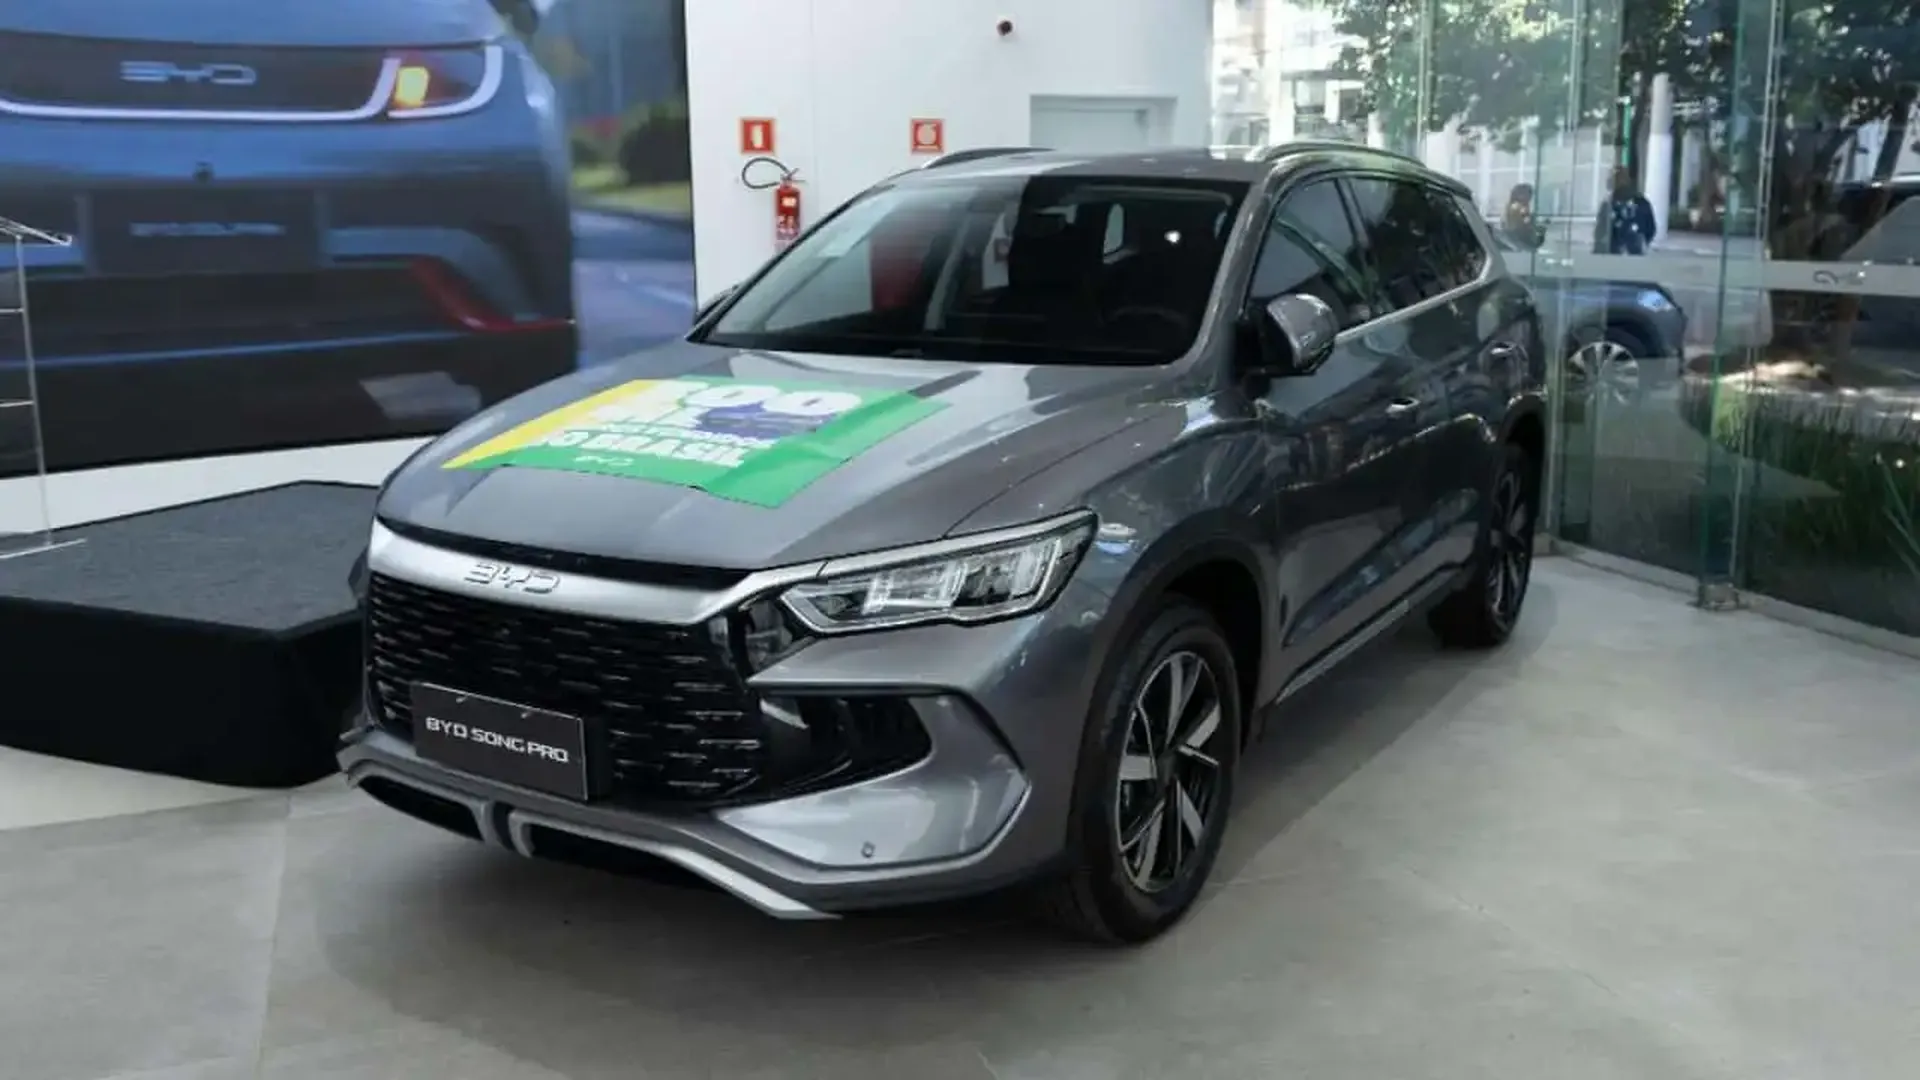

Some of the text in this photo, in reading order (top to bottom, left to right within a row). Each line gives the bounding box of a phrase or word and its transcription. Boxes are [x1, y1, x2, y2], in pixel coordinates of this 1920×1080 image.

[120, 61, 256, 85] BYD
[463, 561, 561, 594] BYD
[425, 716, 569, 763] BYD SONG PRO
